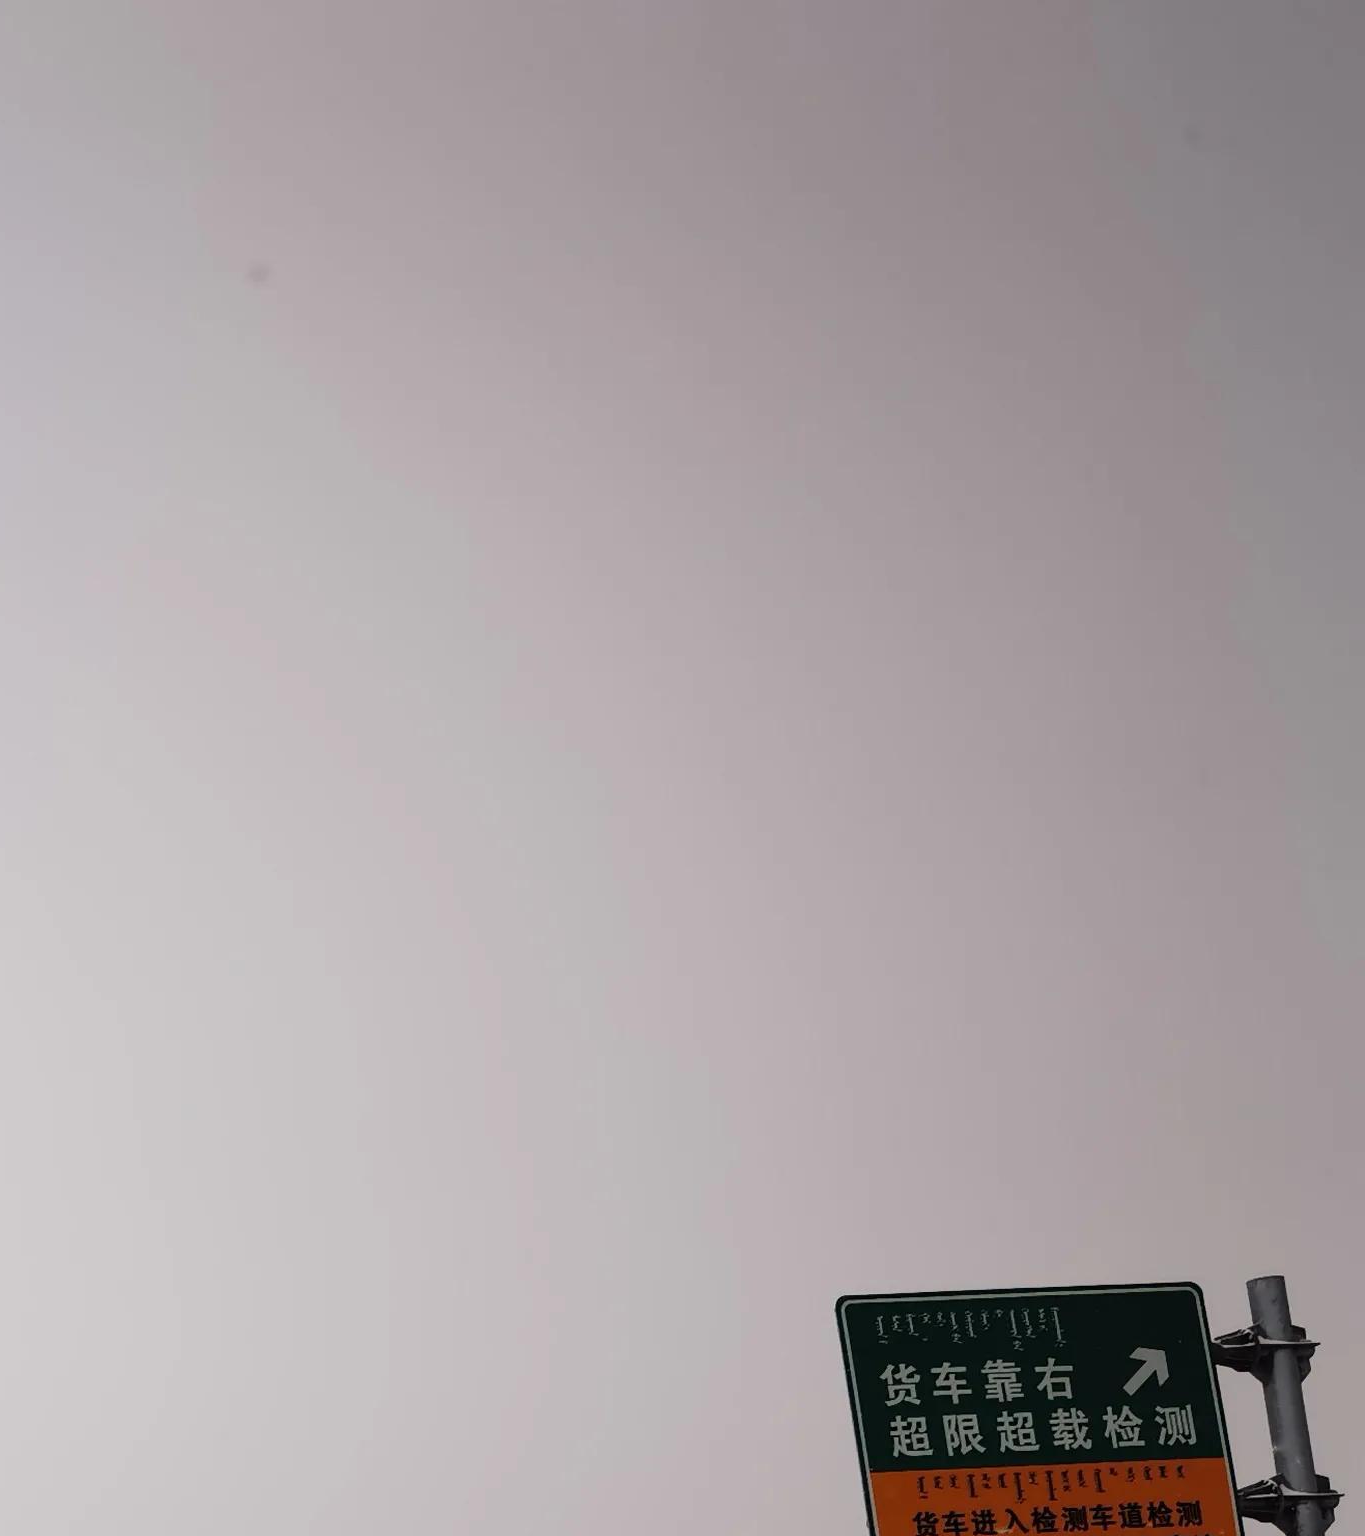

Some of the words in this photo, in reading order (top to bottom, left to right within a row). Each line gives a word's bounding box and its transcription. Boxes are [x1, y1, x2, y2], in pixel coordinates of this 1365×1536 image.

[879, 1358, 1074, 1407] 货车靠右
[890, 1404, 1197, 1457] 超限超载检测
